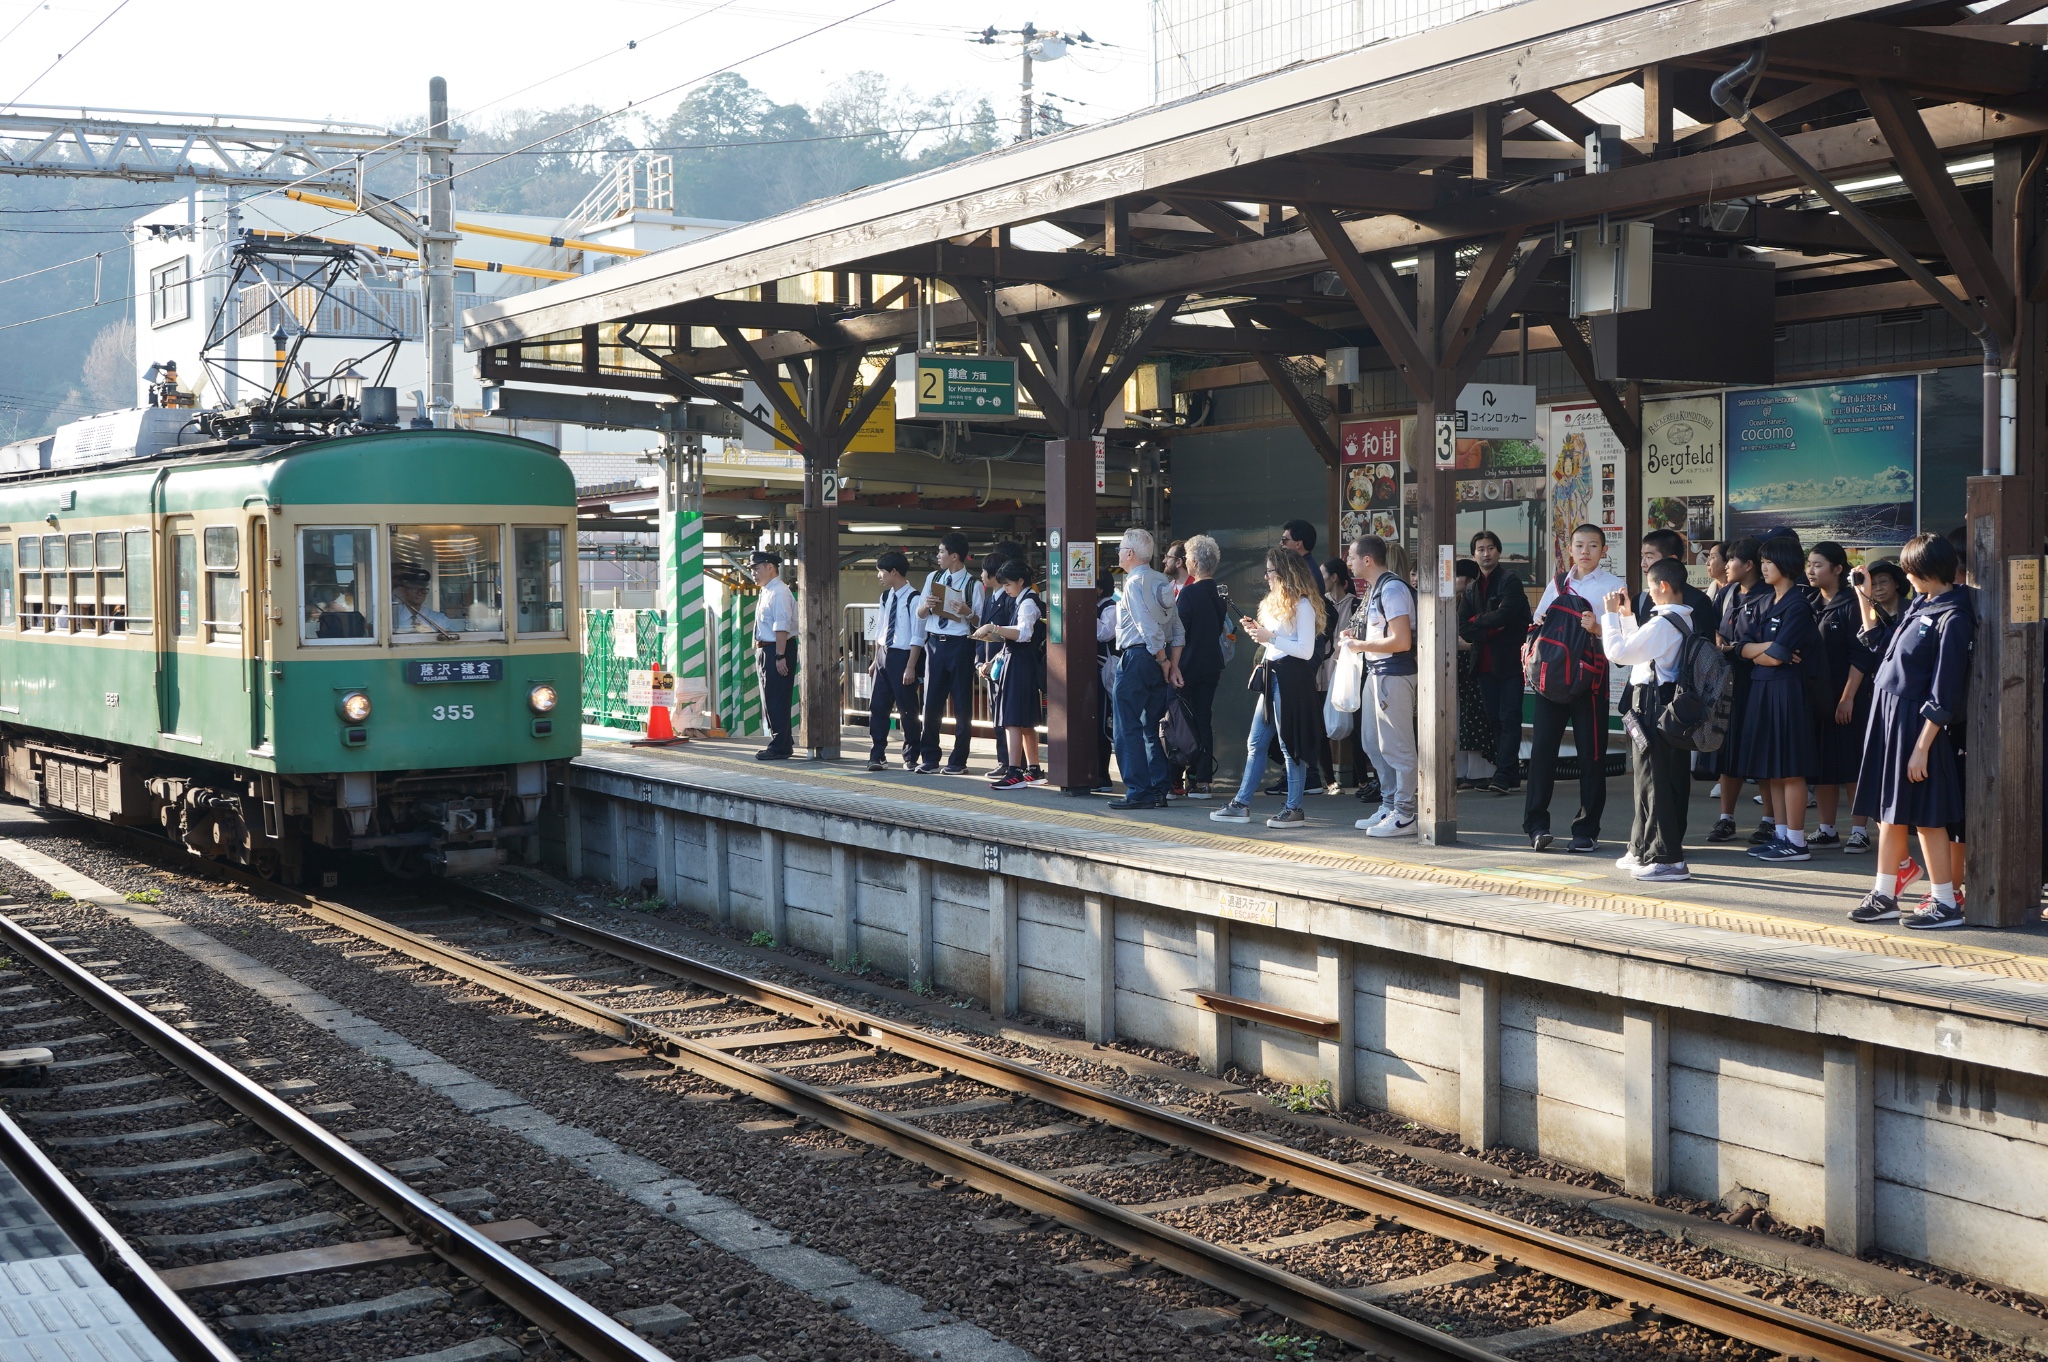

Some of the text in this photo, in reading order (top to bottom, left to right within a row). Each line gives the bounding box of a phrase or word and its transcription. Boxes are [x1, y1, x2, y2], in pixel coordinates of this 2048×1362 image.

[948, 368, 987, 380] 鎌倉 方面
[923, 373, 937, 399] 2
[1761, 397, 1774, 405] Italian
[1775, 396, 1798, 404] Restaurant
[1471, 412, 1527, 424] コインロッカー
[1741, 426, 1794, 441] cocomo
[1361, 430, 1398, 458] 和甘
[1438, 424, 1453, 461] 3
[1647, 443, 1714, 475] Bergfeld
[1485, 469, 1497, 479] Only
[1510, 467, 1520, 475] walk
[1533, 466, 1543, 474] here
[824, 475, 836, 501] 2
[2016, 560, 2035, 570] Please
[2018, 570, 2034, 580] stand
[2016, 582, 2035, 591] behind
[2022, 593, 2032, 602] the
[2016, 603, 2035, 613] yellow
[2021, 613, 2033, 622] line
[432, 704, 475, 721] 355
[1228, 894, 1267, 912] 退避ステップ
[1234, 909, 1259, 922] ESCAPE
[1942, 1032, 1955, 1050] 4
